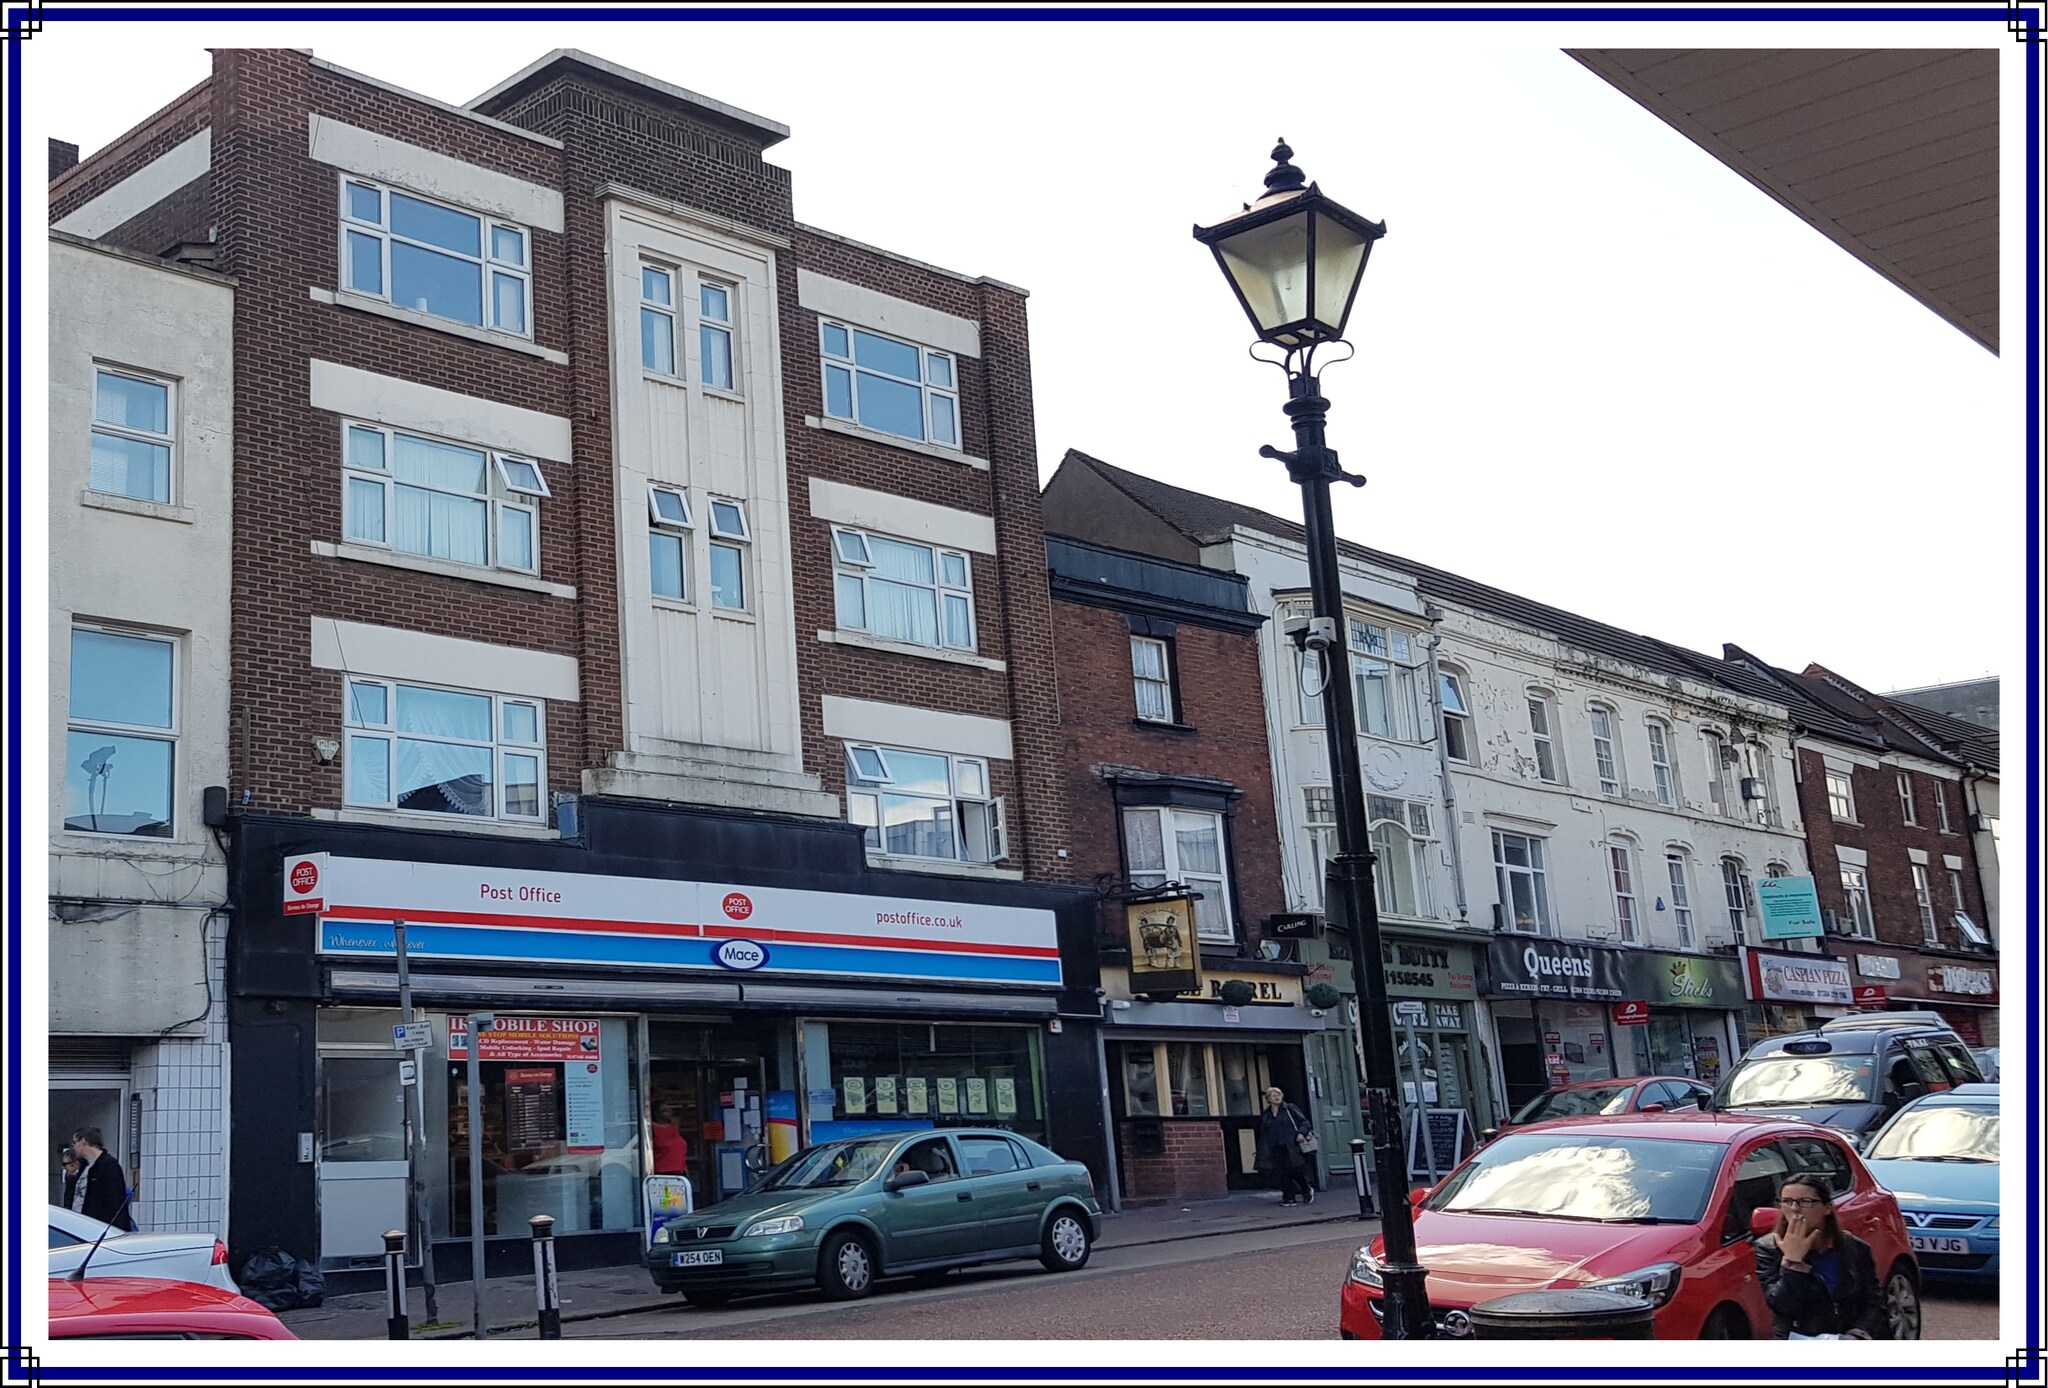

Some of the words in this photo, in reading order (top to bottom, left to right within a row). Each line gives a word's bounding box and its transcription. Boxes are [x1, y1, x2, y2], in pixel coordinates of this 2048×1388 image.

[296, 867, 313, 877] POST
[292, 876, 316, 887] OFFICE
[480, 884, 513, 900] Post
[519, 886, 562, 903] Office
[728, 897, 747, 906] POST
[725, 905, 750, 914] OFFICE
[876, 912, 962, 928] postoffice.co.uk
[1277, 920, 1307, 932] CARLING
[724, 947, 760, 962] Mace
[1524, 947, 1593, 980] Queens
[1784, 965, 1821, 984] CASPIAN
[1822, 970, 1849, 986] PIZZA
[1209, 979, 1282, 1000] BREL
[1392, 1002, 1429, 1026] CFE
[1434, 1004, 1458, 1016] TAKE
[494, 1019, 548, 1032] OBILE
[552, 1020, 598, 1033] SHOP
[1436, 1016, 1461, 1028] AWAY
[1905, 1038, 1929, 1048] TAXI
[1929, 1238, 1962, 1252] VJG
[679, 1252, 701, 1265] W254
[703, 1251, 721, 1263] OEN
